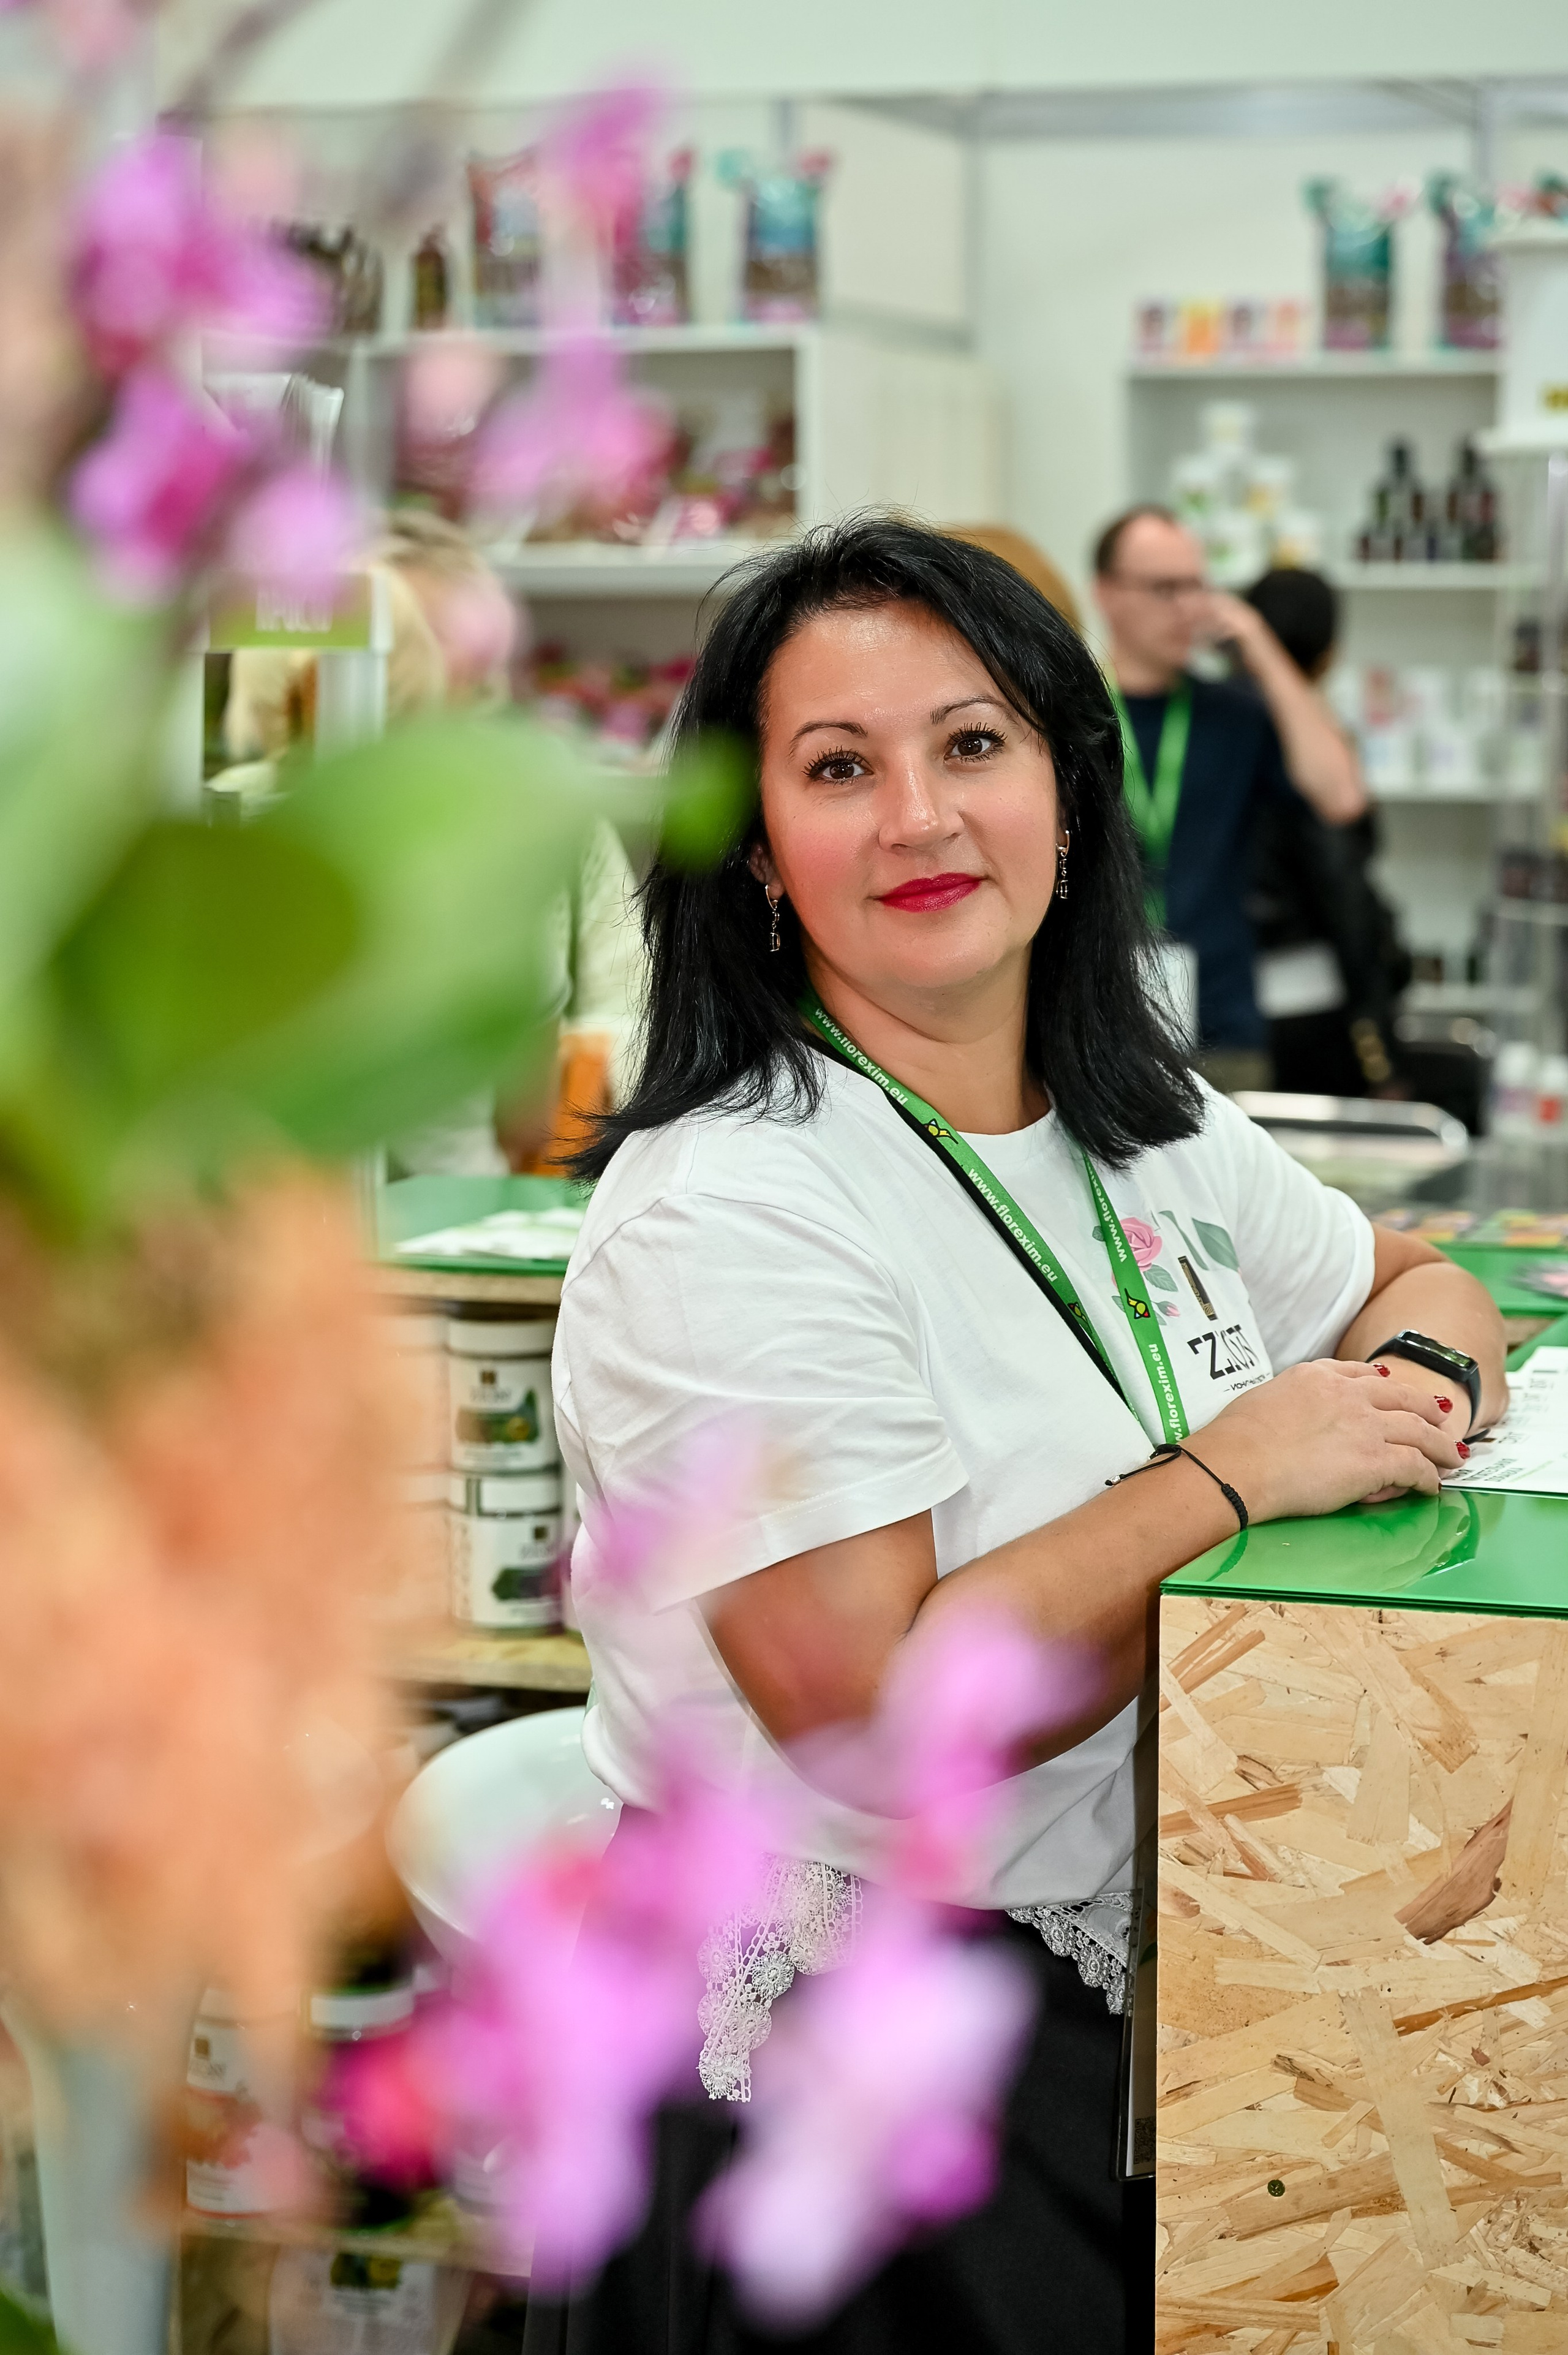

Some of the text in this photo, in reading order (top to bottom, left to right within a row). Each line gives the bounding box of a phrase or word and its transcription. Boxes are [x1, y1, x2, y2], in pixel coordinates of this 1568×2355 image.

[815, 1008, 908, 1106] www.florexim.eu
[968, 1168, 1058, 1282] www.florexim.eu
[1084, 1152, 1127, 1263] www.florexi
[1148, 1344, 1184, 1442] w.florexim.eu
